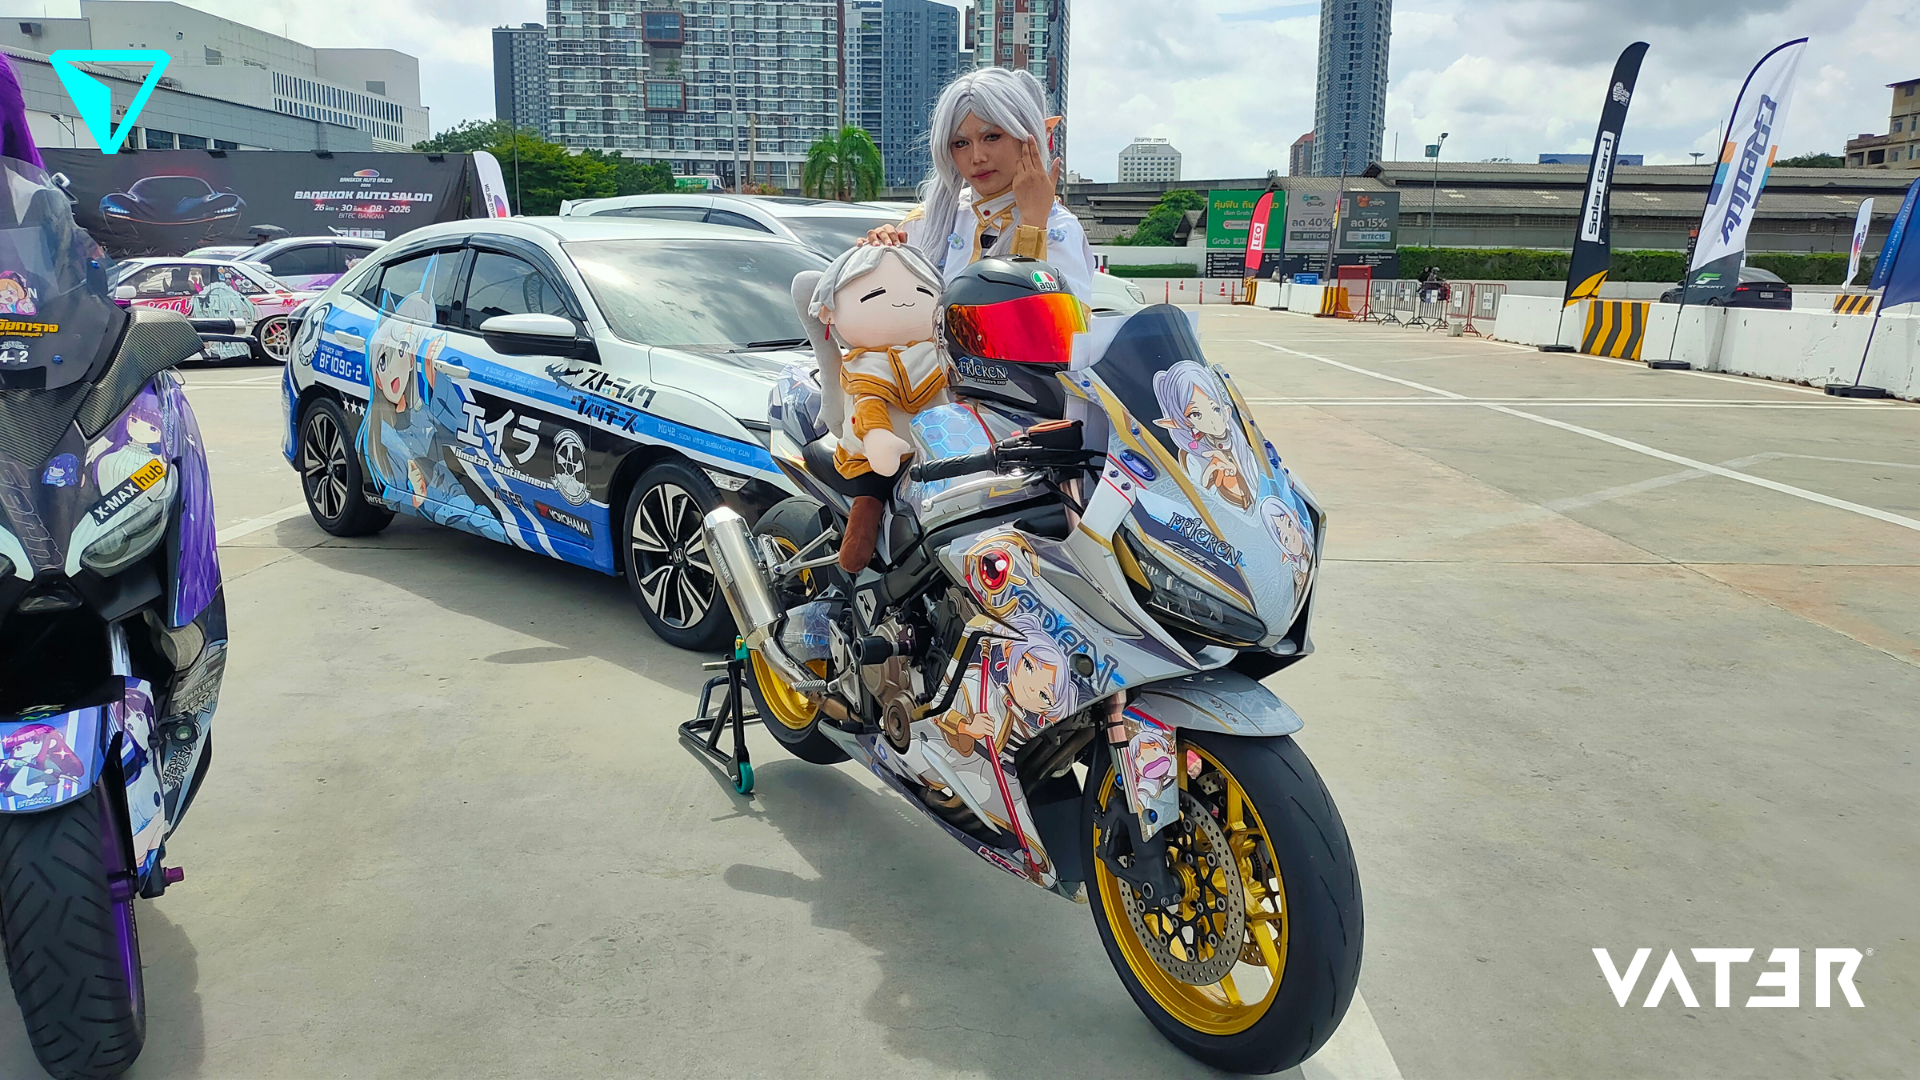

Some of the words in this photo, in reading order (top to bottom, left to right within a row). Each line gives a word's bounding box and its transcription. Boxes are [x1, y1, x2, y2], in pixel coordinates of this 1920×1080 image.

[294, 191, 354, 200] BANGKOK
[356, 191, 389, 200] AUTO
[391, 193, 433, 202] SALON
[1588, 186, 1602, 235] Solar
[1597, 137, 1611, 183] Gard
[388, 205, 411, 213] 2026
[1253, 225, 1262, 247] LEO
[1292, 219, 1305, 227] ลด
[1350, 219, 1364, 227] ลด
[580, 368, 657, 409] ストライク
[456, 402, 542, 465] エイラ
[657, 422, 676, 437] MG42
[493, 463, 547, 489] Juutilainen
[93, 482, 139, 521] X-MAX
[134, 463, 163, 487] hub
[548, 508, 591, 536] YOKOHAMA
[977, 846, 1029, 880] HRC
